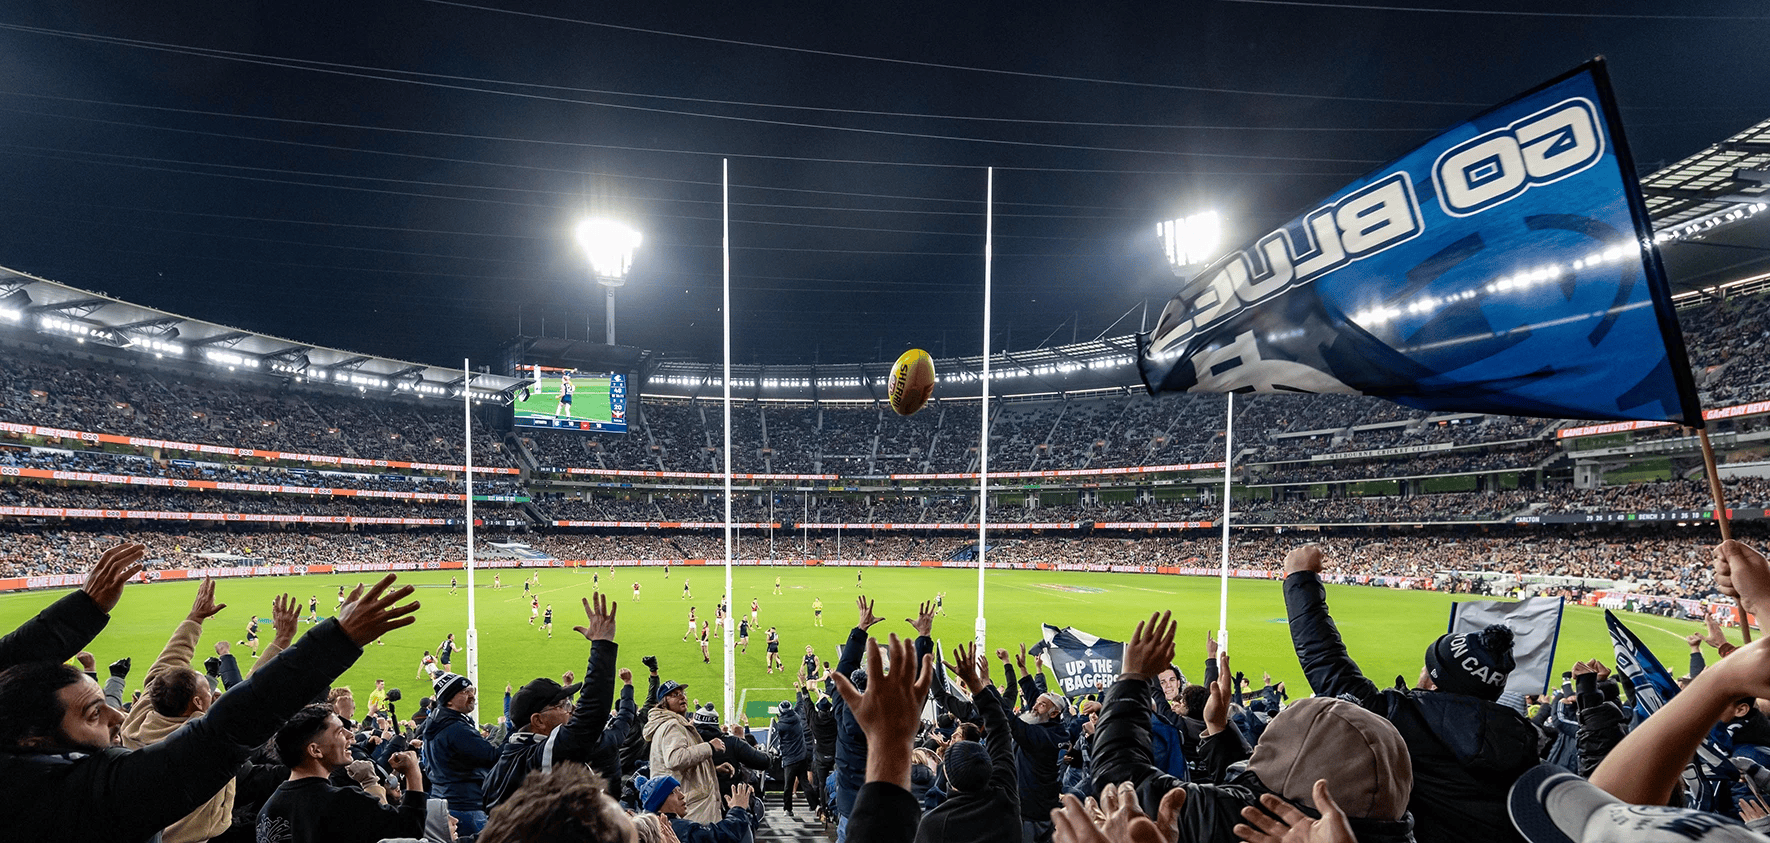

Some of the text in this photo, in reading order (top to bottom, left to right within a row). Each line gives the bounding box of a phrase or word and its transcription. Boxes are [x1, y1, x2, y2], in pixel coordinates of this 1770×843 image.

[1706, 407, 1730, 420] GAME
[1731, 404, 1746, 415] DAY
[1563, 427, 1583, 436] GAME
[1583, 425, 1596, 434] DAY
[1597, 422, 1632, 432] BEVVIES?
[53, 470, 76, 479] GAME
[77, 472, 91, 480] DAY
[92, 473, 127, 483] BEVVIES?
[187, 568, 206, 577] GAME
[207, 568, 220, 576] DAY
[221, 566, 252, 575] BEVVIES?
[254, 565, 270, 574] HERE
[271, 565, 282, 573] FOR
[26, 576, 49, 586] GAME
[49, 576, 63, 585] DAY
[1065, 659, 1113, 676] UP THE
